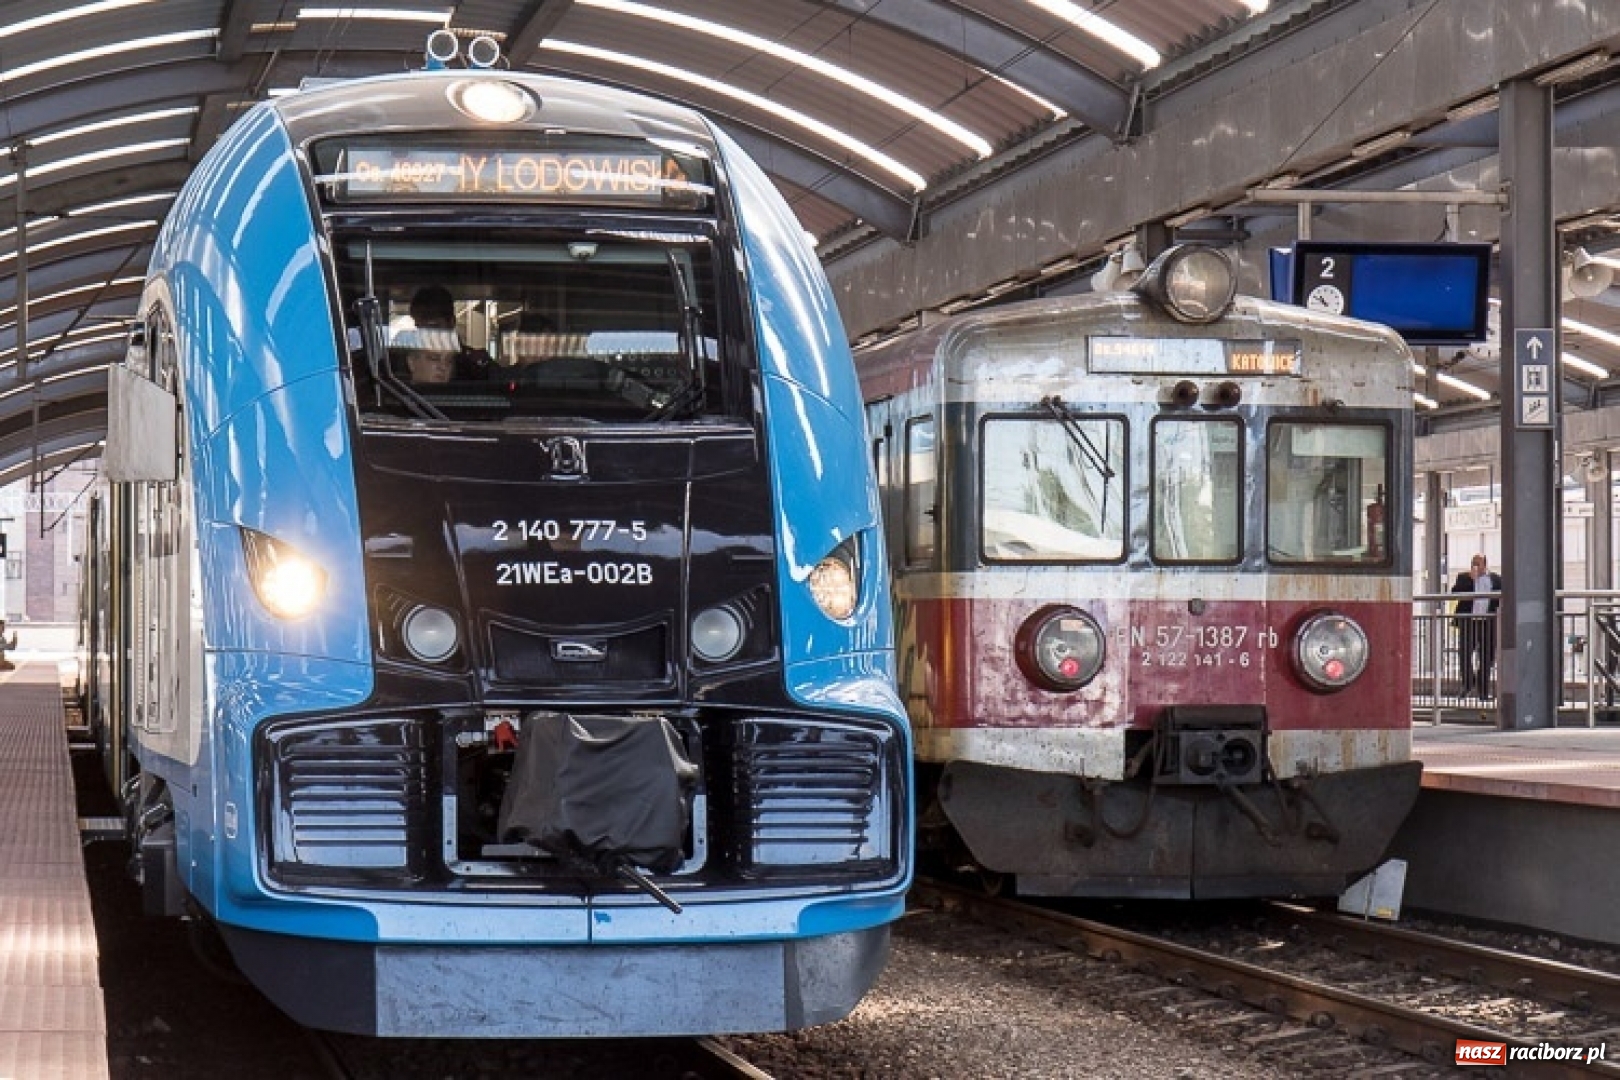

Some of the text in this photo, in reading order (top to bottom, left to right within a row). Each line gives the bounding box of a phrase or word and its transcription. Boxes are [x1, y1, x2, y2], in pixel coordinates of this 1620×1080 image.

[1319, 256, 1336, 279] 2
[491, 520, 647, 541] 2 140 777-5
[496, 562, 653, 584] 21WEa-002B
[1116, 626, 1279, 648] EN 57-1387 rb
[1142, 652, 1152, 666] 2
[1159, 652, 1187, 666] 122
